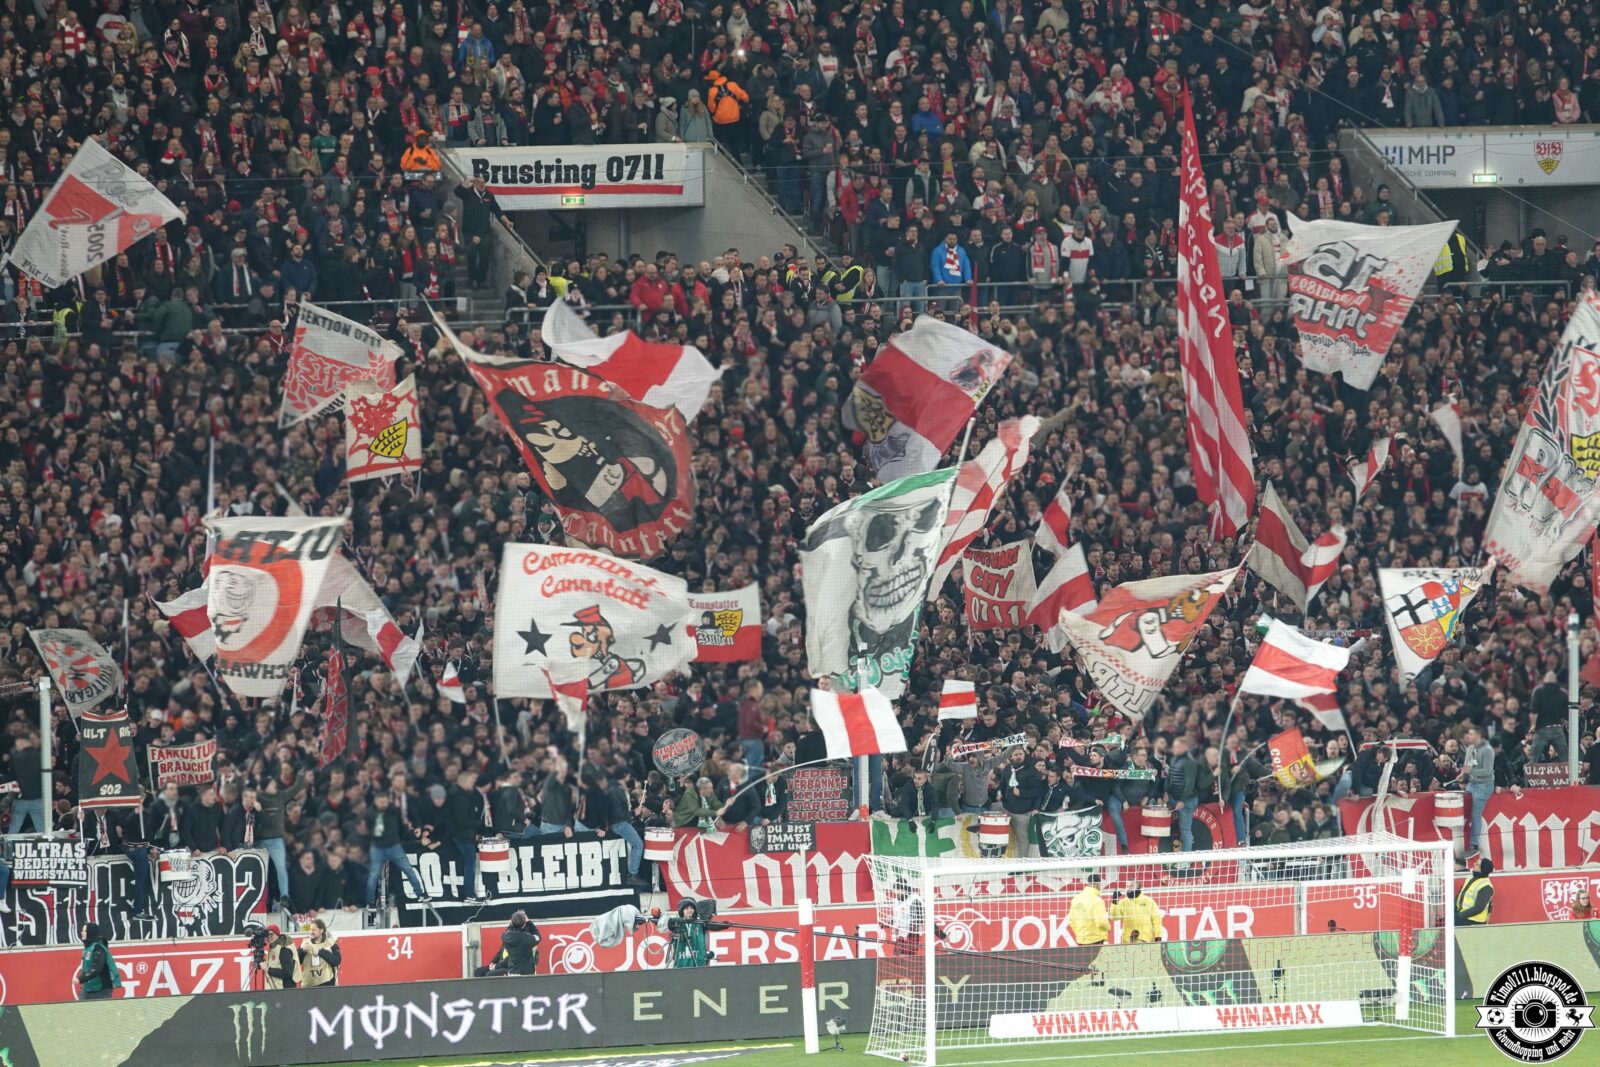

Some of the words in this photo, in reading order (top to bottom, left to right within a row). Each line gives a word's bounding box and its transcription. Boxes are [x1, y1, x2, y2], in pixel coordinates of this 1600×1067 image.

[1408, 145, 1456, 165] MHP
[471, 157, 597, 190] Brustring
[606, 154, 665, 182] 0711
[970, 565, 1015, 599] CITY
[541, 575, 651, 610] Cannstatt
[971, 596, 1021, 627] 0711
[150, 740, 217, 761] FANKULTUR
[160, 760, 210, 774] BRAUCHT
[794, 769, 841, 780] JEDER
[787, 777, 848, 791] VERBANNTE
[793, 789, 842, 801] KEHRT
[767, 824, 782, 834] DU
[787, 823, 812, 834] BIST
[767, 833, 812, 843] IMMER
[14, 841, 86, 859] ULTRAS
[767, 842, 785, 851] BEI
[14, 857, 86, 870] BEDEUTET
[497, 838, 627, 894] BLEIBT
[13, 869, 87, 881] WIDERSTAND
[1352, 885, 1378, 909] 35
[387, 935, 414, 961] 34
[615, 929, 887, 971] JOERSAR
[310, 969, 323, 978] TV
[1032, 1010, 1140, 1035] WINAMAX
[1216, 1003, 1325, 1028] WINAMAX
